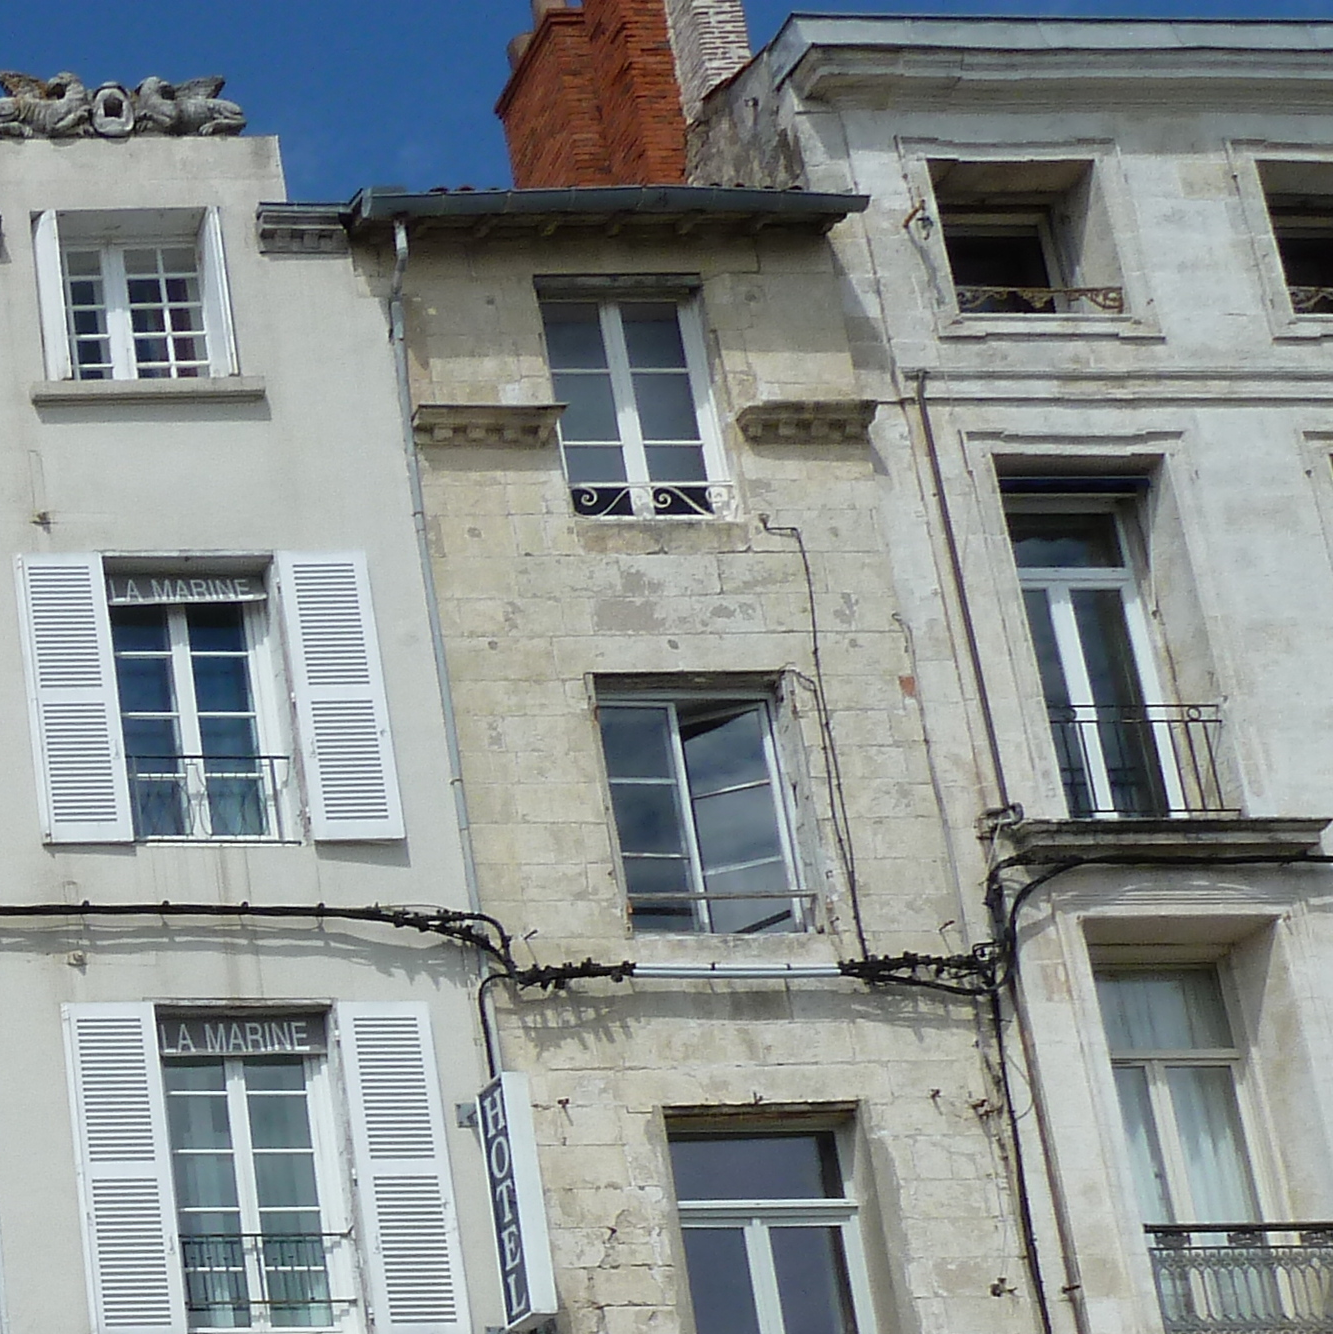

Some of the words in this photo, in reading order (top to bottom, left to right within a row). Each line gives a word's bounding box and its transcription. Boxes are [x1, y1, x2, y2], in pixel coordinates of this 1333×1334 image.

[109, 578, 144, 602] LA
[151, 578, 254, 600] MARINE
[160, 1023, 196, 1053] LA
[204, 1021, 310, 1052] MARINE
[483, 1087, 528, 1316] HOTEL
